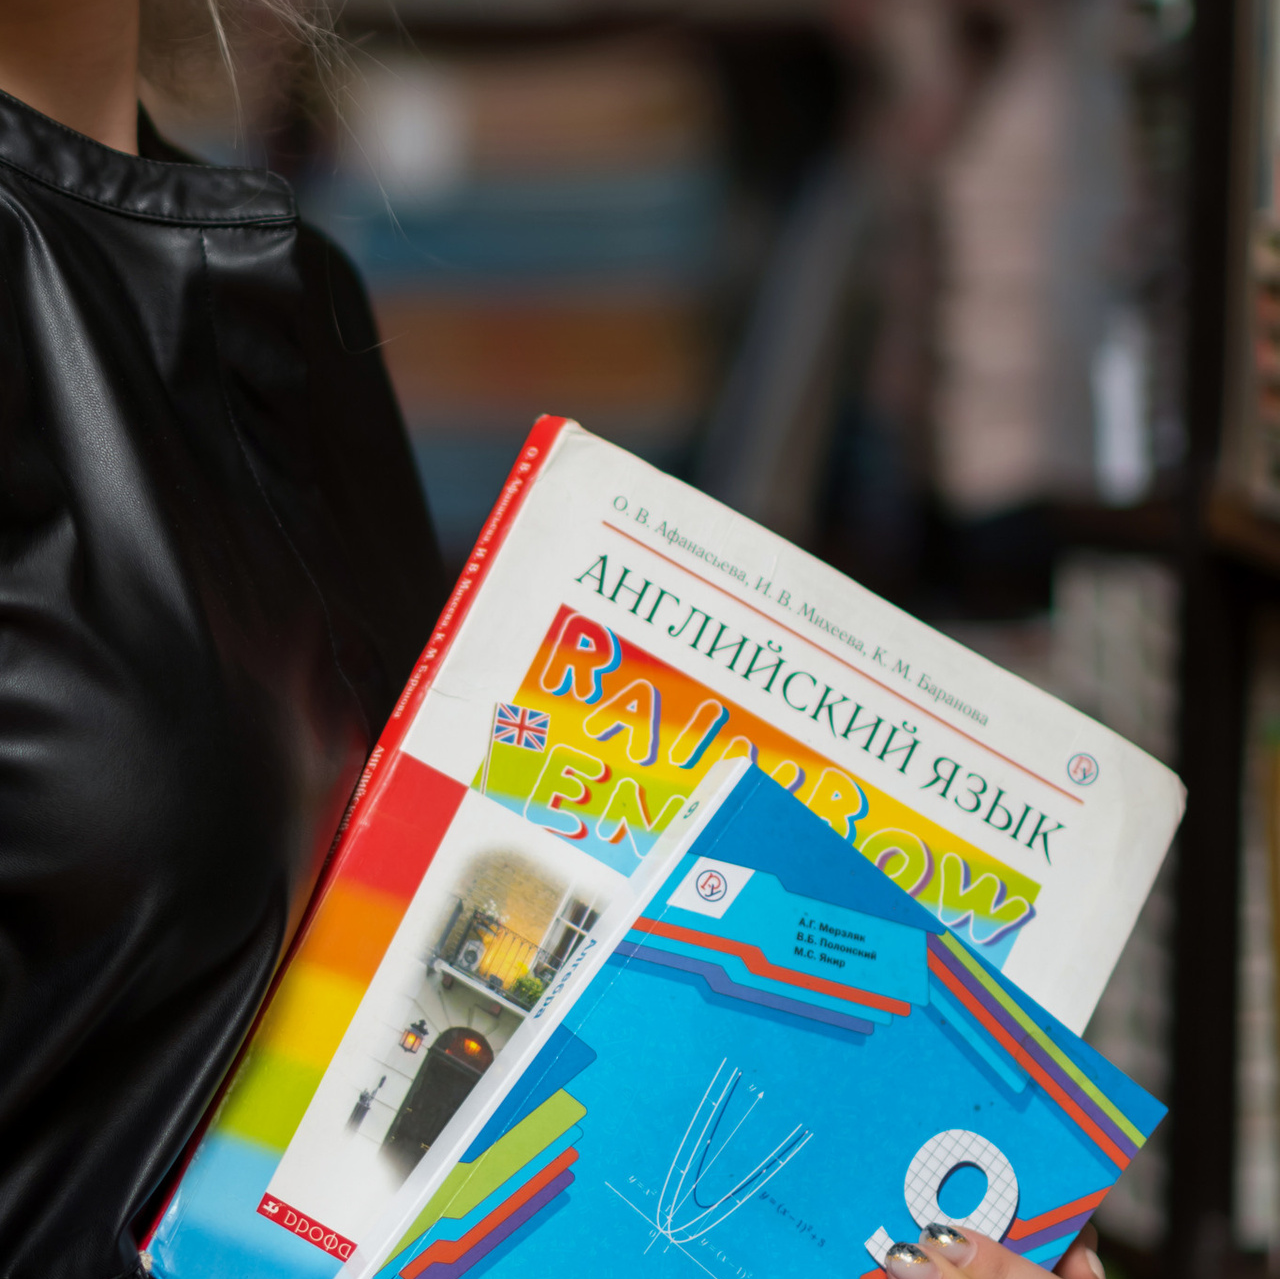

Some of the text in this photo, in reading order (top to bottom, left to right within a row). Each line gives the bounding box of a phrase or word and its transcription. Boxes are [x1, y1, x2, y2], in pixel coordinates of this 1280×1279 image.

[613, 495, 989, 727] О. В. Афанасьева, И. В. Михеева, К. М. Баранова
[393, 664, 428, 720] Баранова
[574, 553, 1067, 866] АНГЛИЙСКИЙ ЯЗЫК
[539, 612, 1036, 946] RAIBOW
[793, 946, 846, 968] М.С. Якир
[796, 931, 877, 961] В.Б. Полонский
[798, 917, 866, 943] А.Г. Мерзляк
[532, 938, 598, 1019] Алгебра
